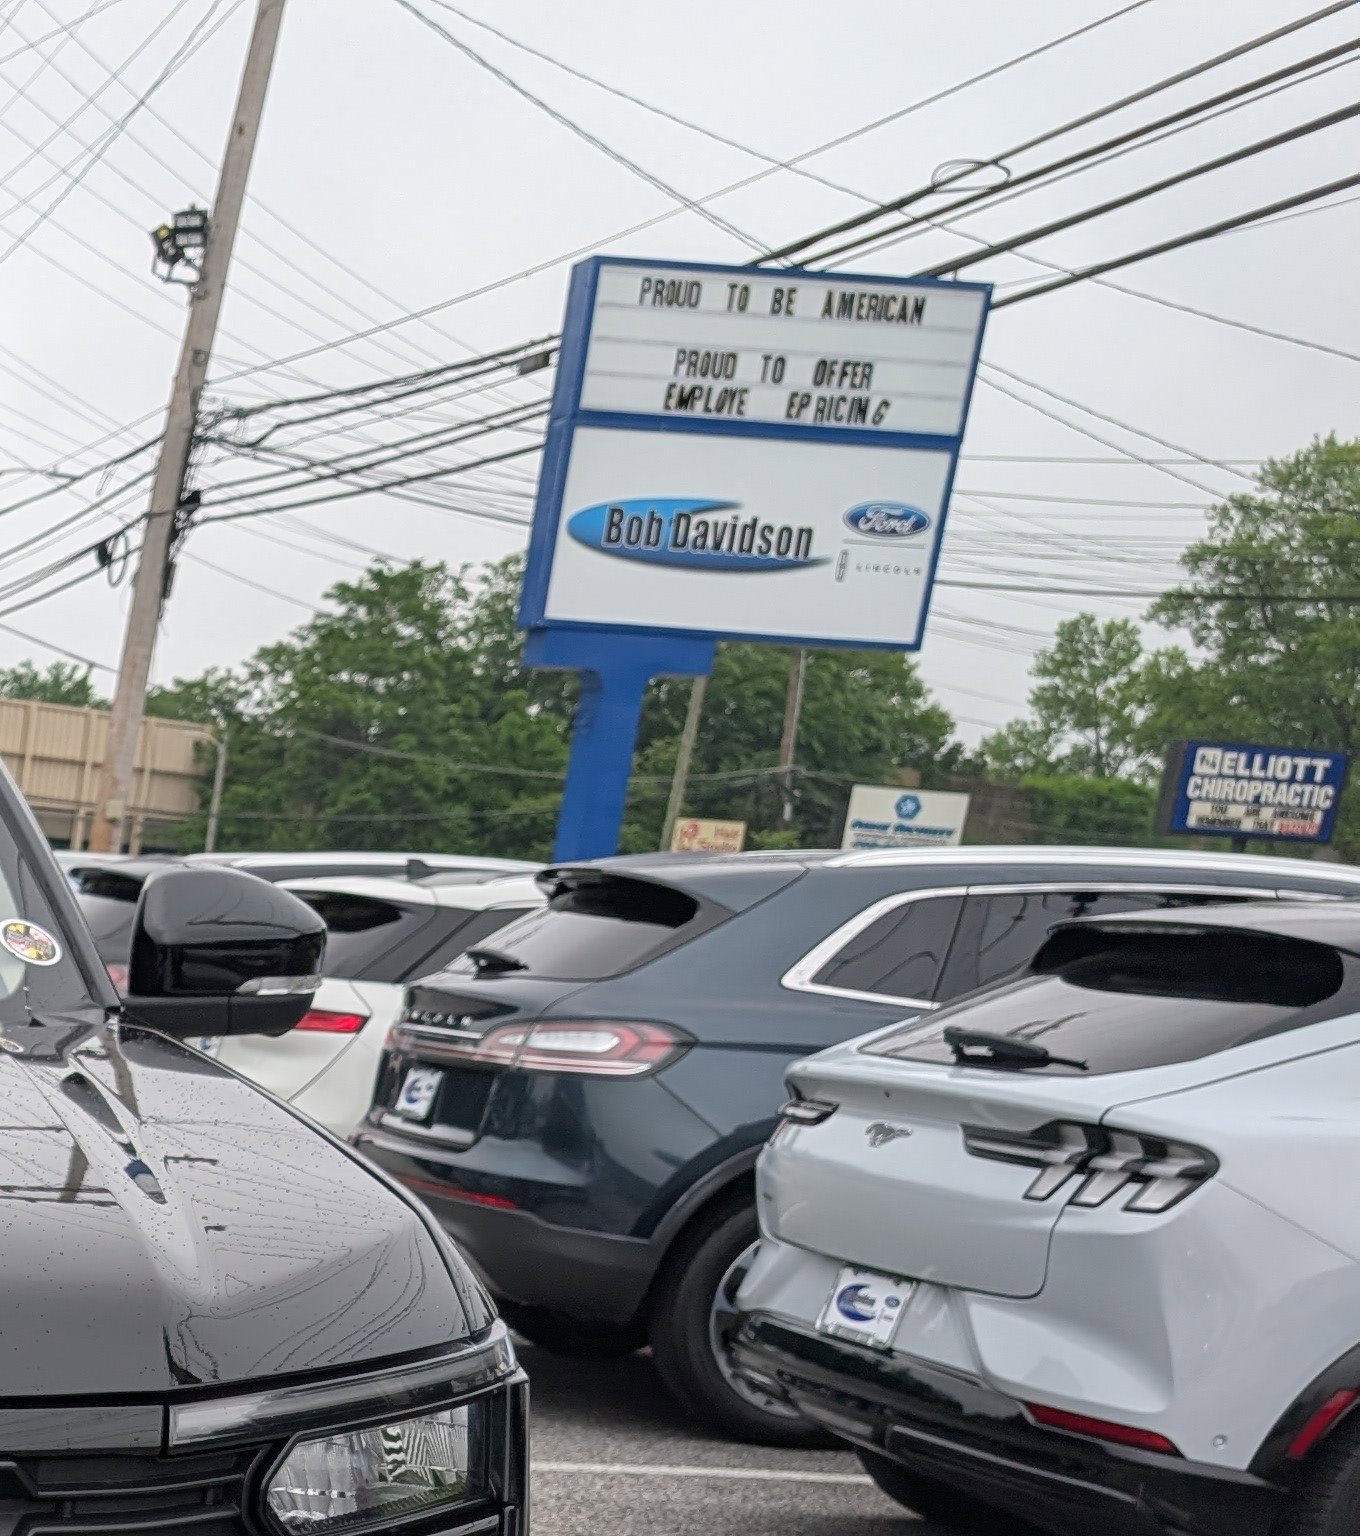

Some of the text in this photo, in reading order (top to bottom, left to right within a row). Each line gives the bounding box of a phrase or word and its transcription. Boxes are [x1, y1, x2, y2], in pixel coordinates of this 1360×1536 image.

[639, 277, 927, 325] PROUD TO BE AMERICAN
[673, 349, 874, 391] PROUD TO OFFER
[663, 382, 749, 416] EMPLOYE
[603, 506, 815, 559] Bob Davidson
[858, 506, 917, 534] Ford
[1220, 751, 1333, 783] ELLIOTT
[1187, 776, 1335, 810] CHIROPRACTIC
